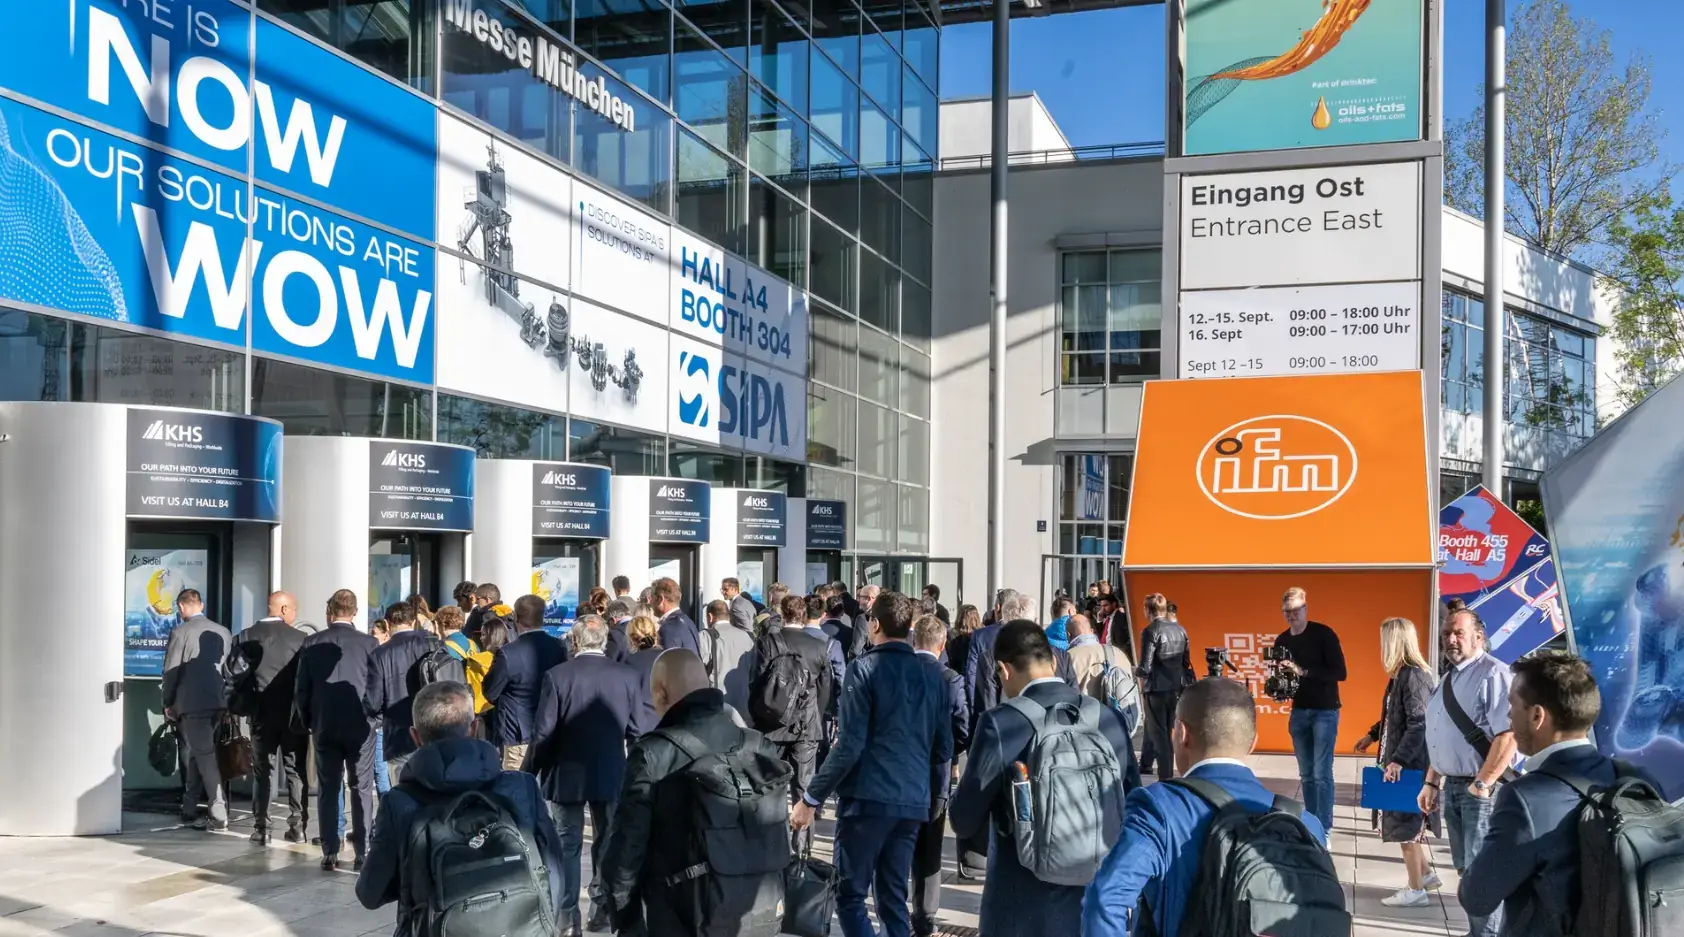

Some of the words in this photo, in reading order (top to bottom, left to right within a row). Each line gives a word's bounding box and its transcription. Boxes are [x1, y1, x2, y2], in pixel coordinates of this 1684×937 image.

[187, 5, 219, 48] IS
[446, 0, 532, 69] Messe
[536, 36, 635, 133] München
[88, 4, 347, 188] NOW
[1338, 114, 1406, 124] oils-and-fats.com
[1191, 181, 1306, 208] Eingang
[1315, 176, 1365, 199] Ost
[46, 129, 144, 205] OUR
[158, 166, 355, 257] SOLUTIONS
[363, 236, 420, 278] ARE
[588, 203, 636, 236] DISCOVER
[1191, 214, 1312, 239] Entrance
[1323, 208, 1384, 232] East
[588, 225, 642, 260] SOLUTIONS
[643, 250, 655, 265] AT
[131, 201, 433, 369] WOW
[682, 246, 740, 300] HALL
[742, 277, 768, 314] A4
[681, 288, 752, 344] BOOTH
[757, 321, 791, 359] 304
[1238, 312, 1274, 325] Sept.
[1289, 309, 1327, 320] 09:00
[1342, 307, 1379, 318] 18:00
[1384, 305, 1411, 317] Uhr
[1188, 330, 1208, 341] 16.
[1211, 329, 1243, 342] Sept
[1289, 325, 1327, 337] 09:00
[1342, 323, 1379, 335] 17:00
[1384, 322, 1411, 334] Uhr
[1188, 360, 1217, 374] Sept
[1221, 359, 1237, 370] 12
[1289, 356, 1327, 368] 09:00
[1341, 355, 1379, 367] 18:00
[718, 364, 790, 447] SIPA
[165, 424, 203, 442] KHS
[141, 463, 158, 471] OUR
[160, 464, 179, 472] PATH
[198, 467, 217, 475] YOUR
[218, 468, 239, 476] FUTURE
[399, 453, 426, 467] KHS
[1213, 428, 1338, 493] ifm
[555, 473, 576, 485] KHS
[141, 495, 165, 505] VISIT
[167, 497, 180, 506] US
[181, 498, 195, 506] AT
[195, 498, 217, 507] HALL
[218, 499, 229, 508] B4
[668, 487, 685, 498] KHS
[752, 498, 767, 507] KHS
[819, 506, 832, 515] KHS
[380, 510, 399, 519] VISIT
[401, 511, 410, 519] US
[410, 511, 420, 519] AT
[420, 512, 435, 520] HALL
[436, 513, 444, 521] B4
[1439, 534, 1478, 547] Booth
[1481, 534, 1509, 547] 455
[1525, 543, 1547, 556] RC
[142, 556, 161, 566] Sidel
[1438, 549, 1449, 561] at
[1455, 549, 1480, 562] Hall
[1486, 549, 1507, 562] A5
[128, 638, 147, 646] SHAPE
[148, 639, 163, 647] YOUR
